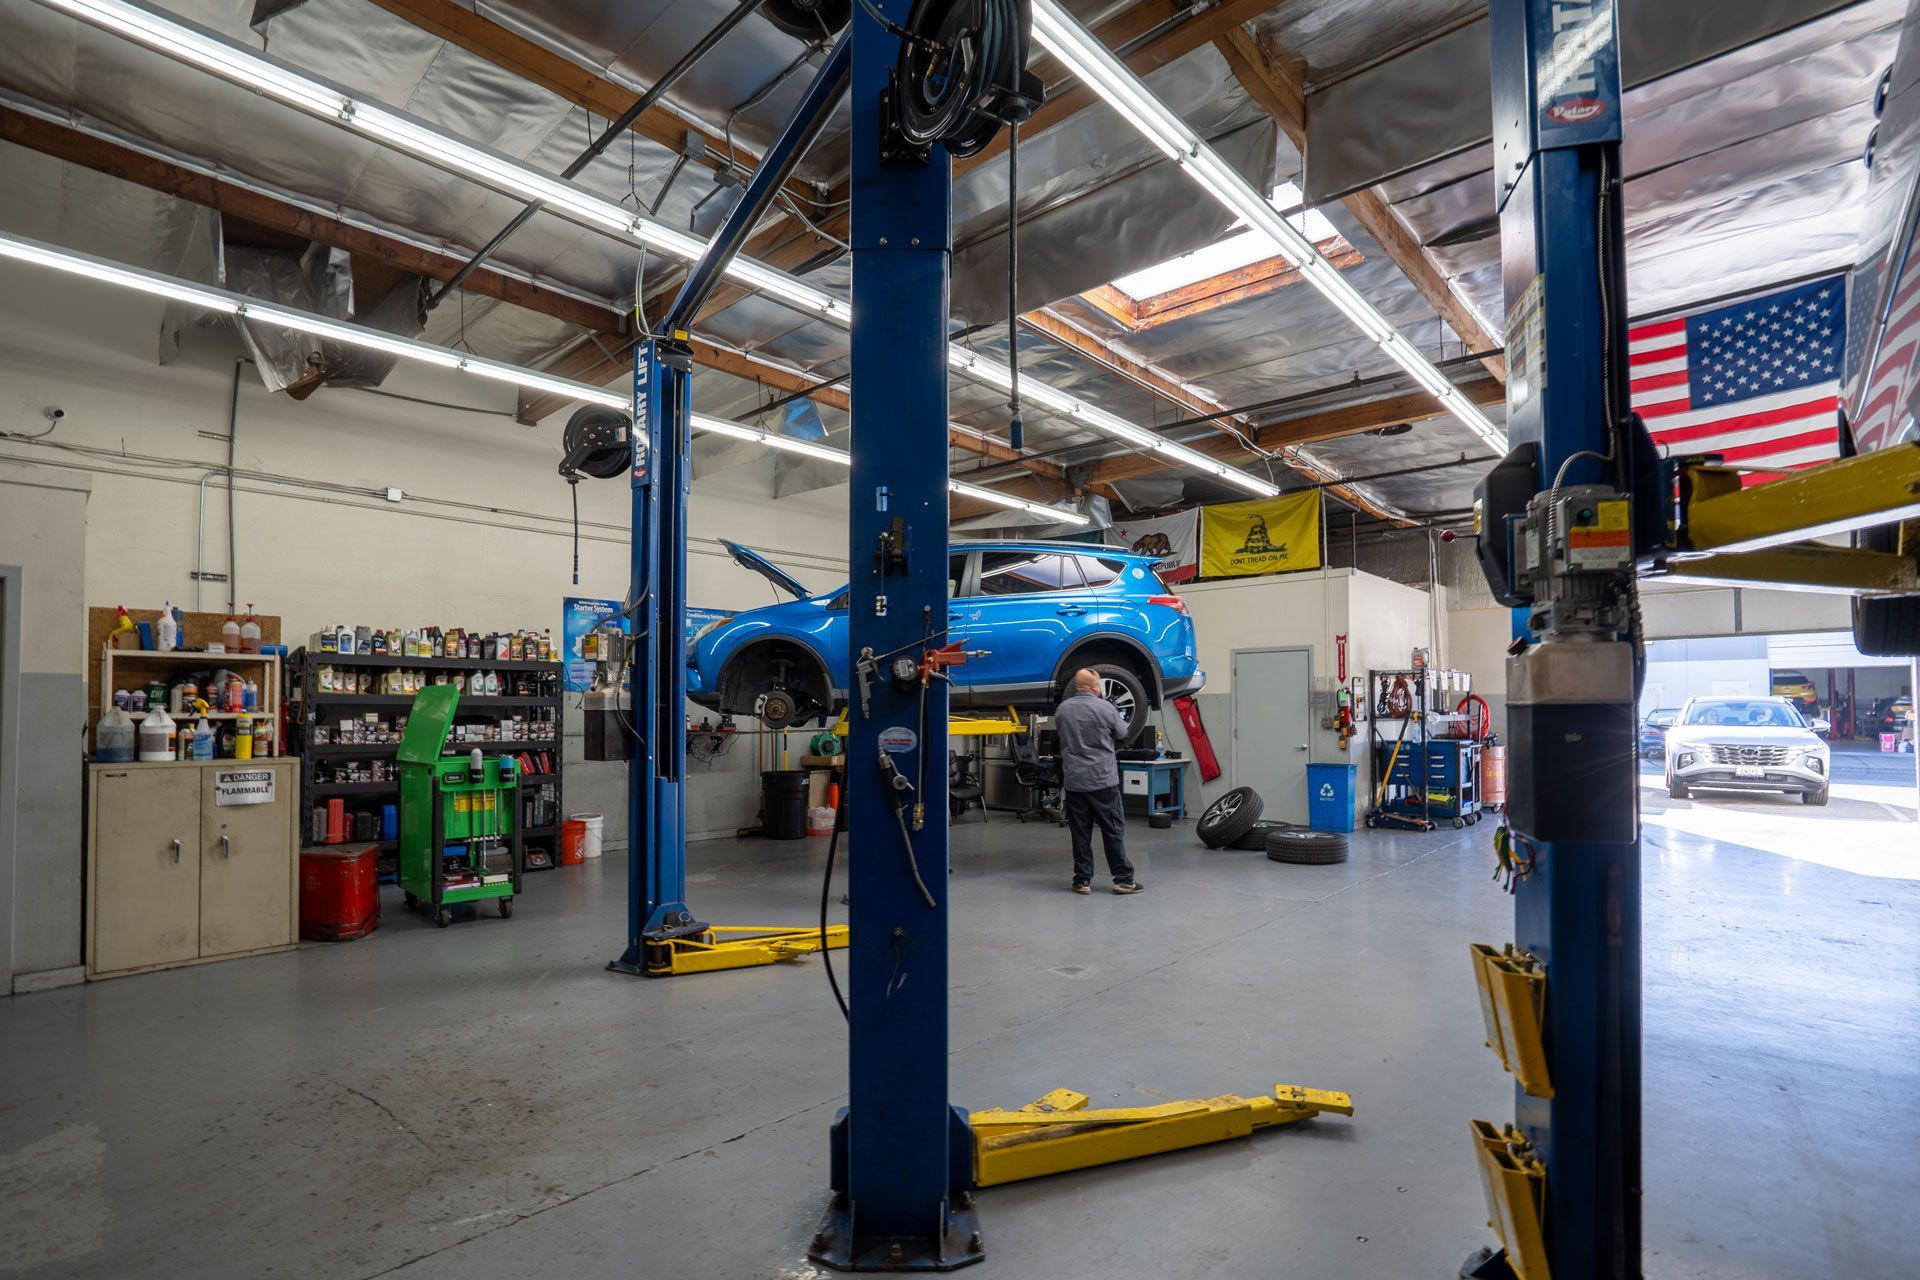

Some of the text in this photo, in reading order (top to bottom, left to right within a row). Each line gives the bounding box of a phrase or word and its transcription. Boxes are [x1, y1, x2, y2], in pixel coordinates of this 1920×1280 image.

[1551, 104, 1600, 120] Rotary
[637, 346, 649, 387] LIFT
[1247, 555, 1267, 563] TREAD
[573, 603, 593, 612] Starter
[593, 605, 613, 613] System
[233, 773, 269, 781] DANGER
[221, 787, 270, 795] FLAMMABLE
